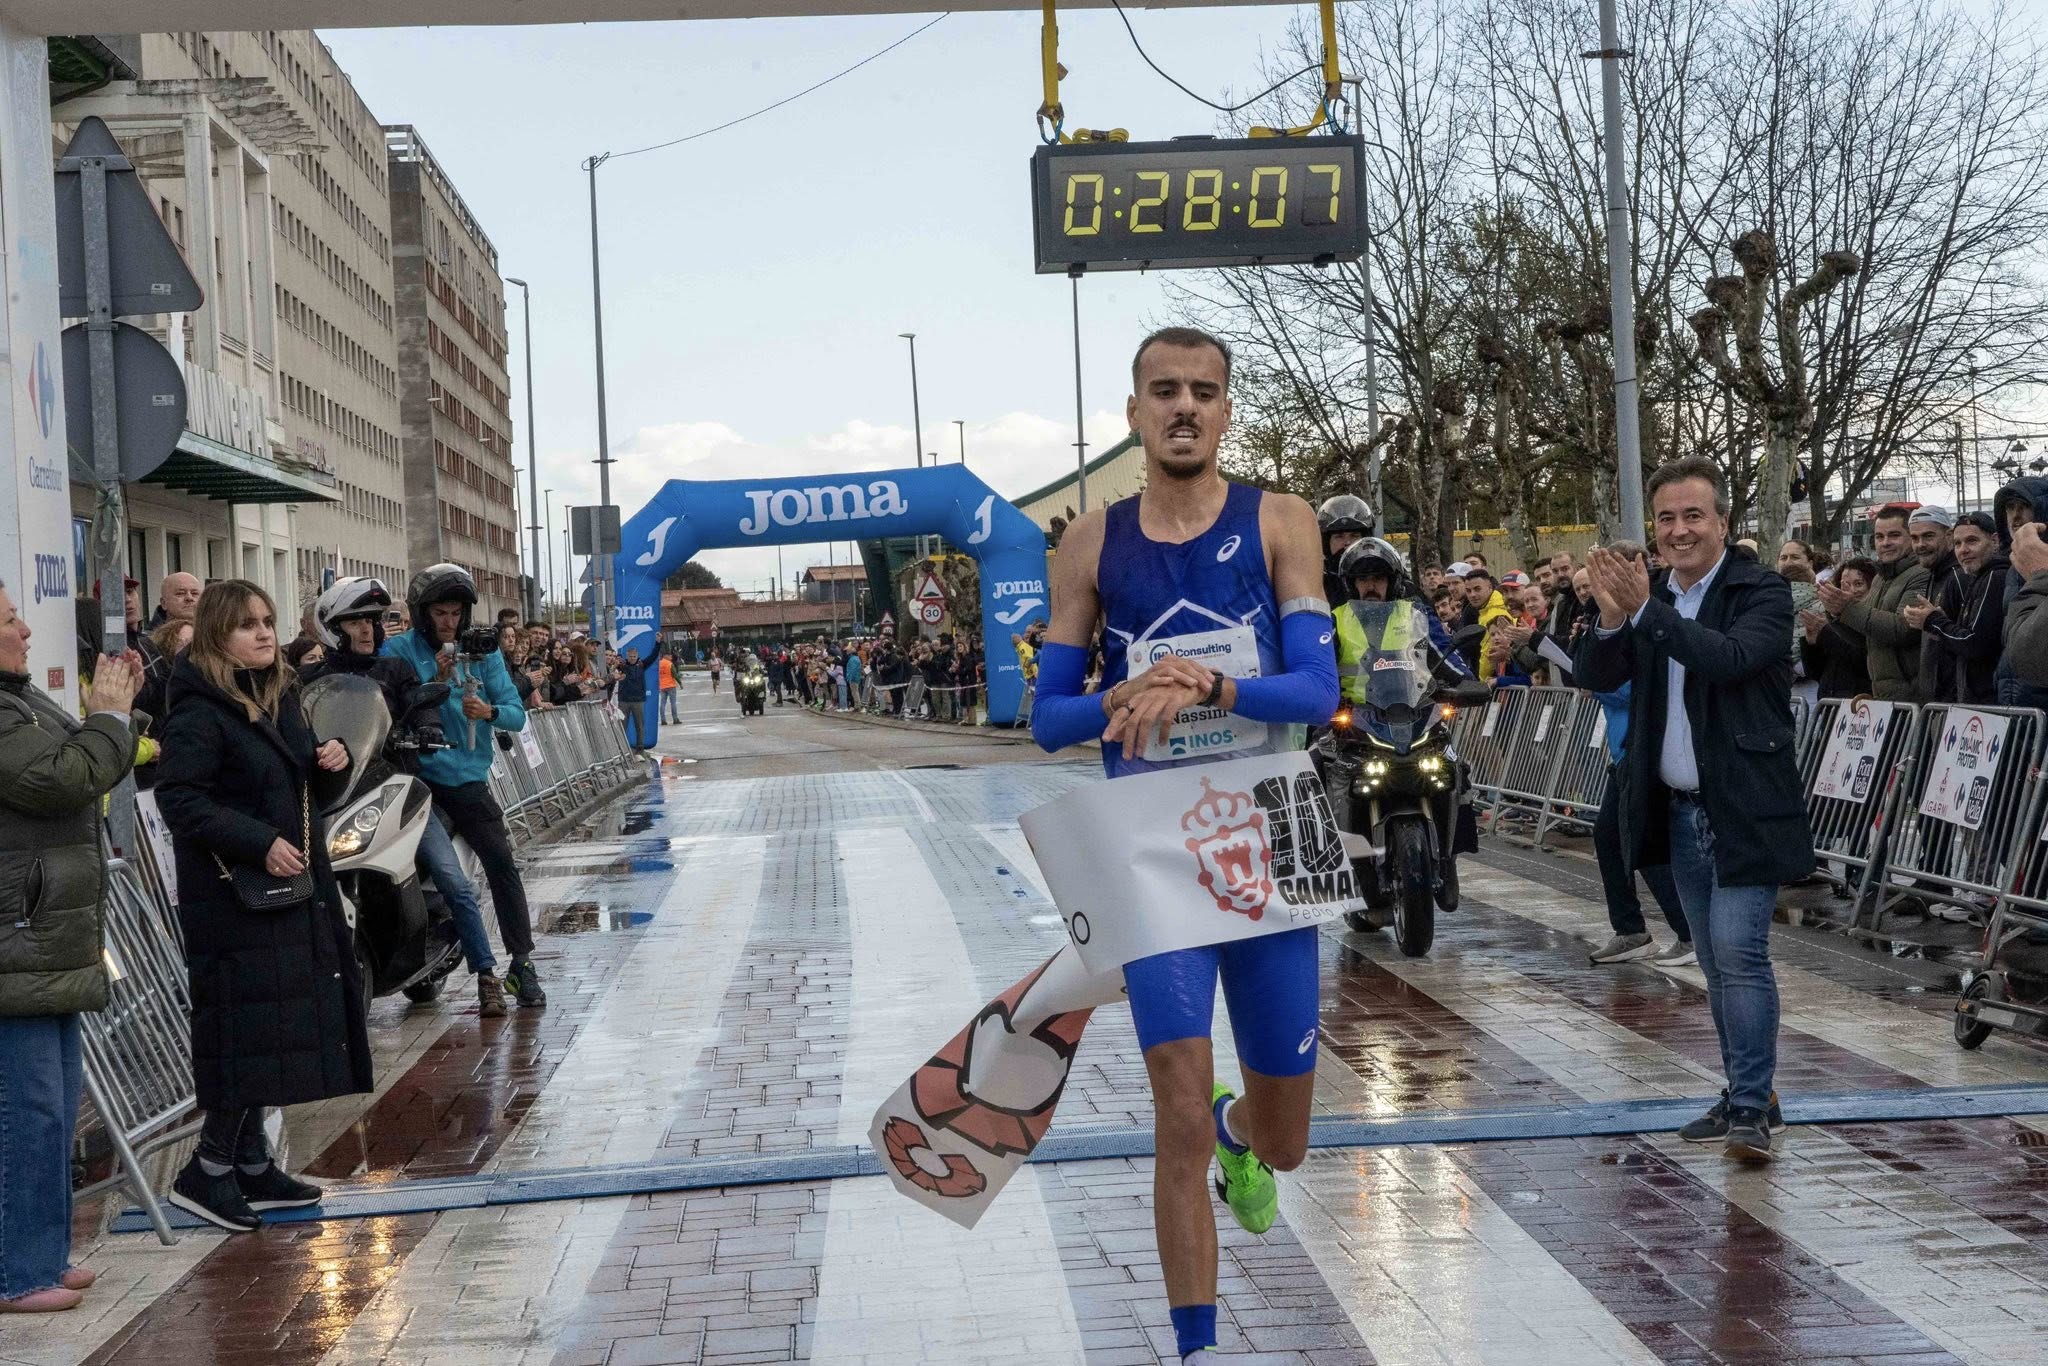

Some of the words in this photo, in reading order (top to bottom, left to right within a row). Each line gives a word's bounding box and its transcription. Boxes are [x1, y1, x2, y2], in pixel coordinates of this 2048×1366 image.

[1063, 163, 1342, 236] 0:28:07
[29, 455, 62, 492] Carrefour
[614, 605, 655, 620] oma
[925, 609, 940, 618] 30
[1175, 643, 1232, 657] Consulting
[1189, 729, 1234, 748] INOS
[1970, 780, 1987, 801] Font
